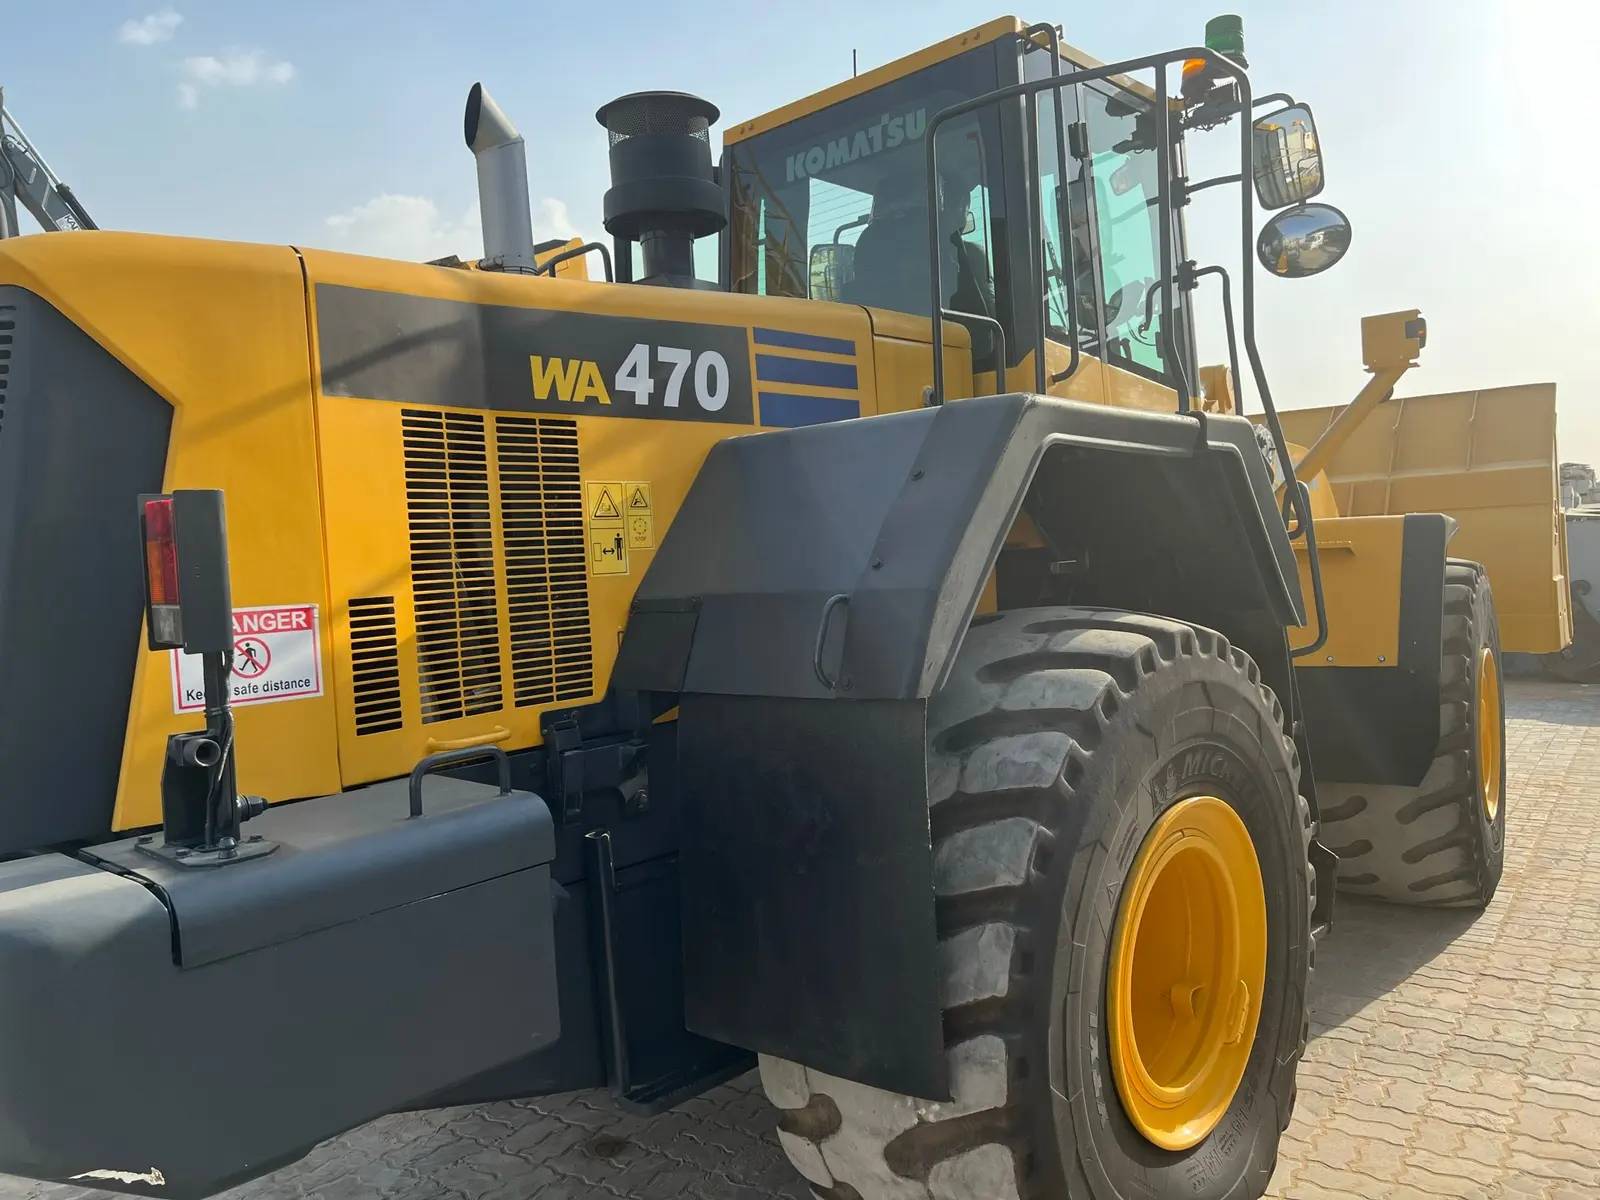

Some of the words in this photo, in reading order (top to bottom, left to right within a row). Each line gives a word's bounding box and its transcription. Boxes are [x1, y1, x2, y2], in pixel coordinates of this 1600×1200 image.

[786, 107, 926, 182] KOMATSU
[530, 355, 612, 405] WA
[615, 343, 730, 411] 470
[232, 611, 308, 633] ANGER
[233, 683, 259, 696] safe
[262, 678, 311, 692] distance
